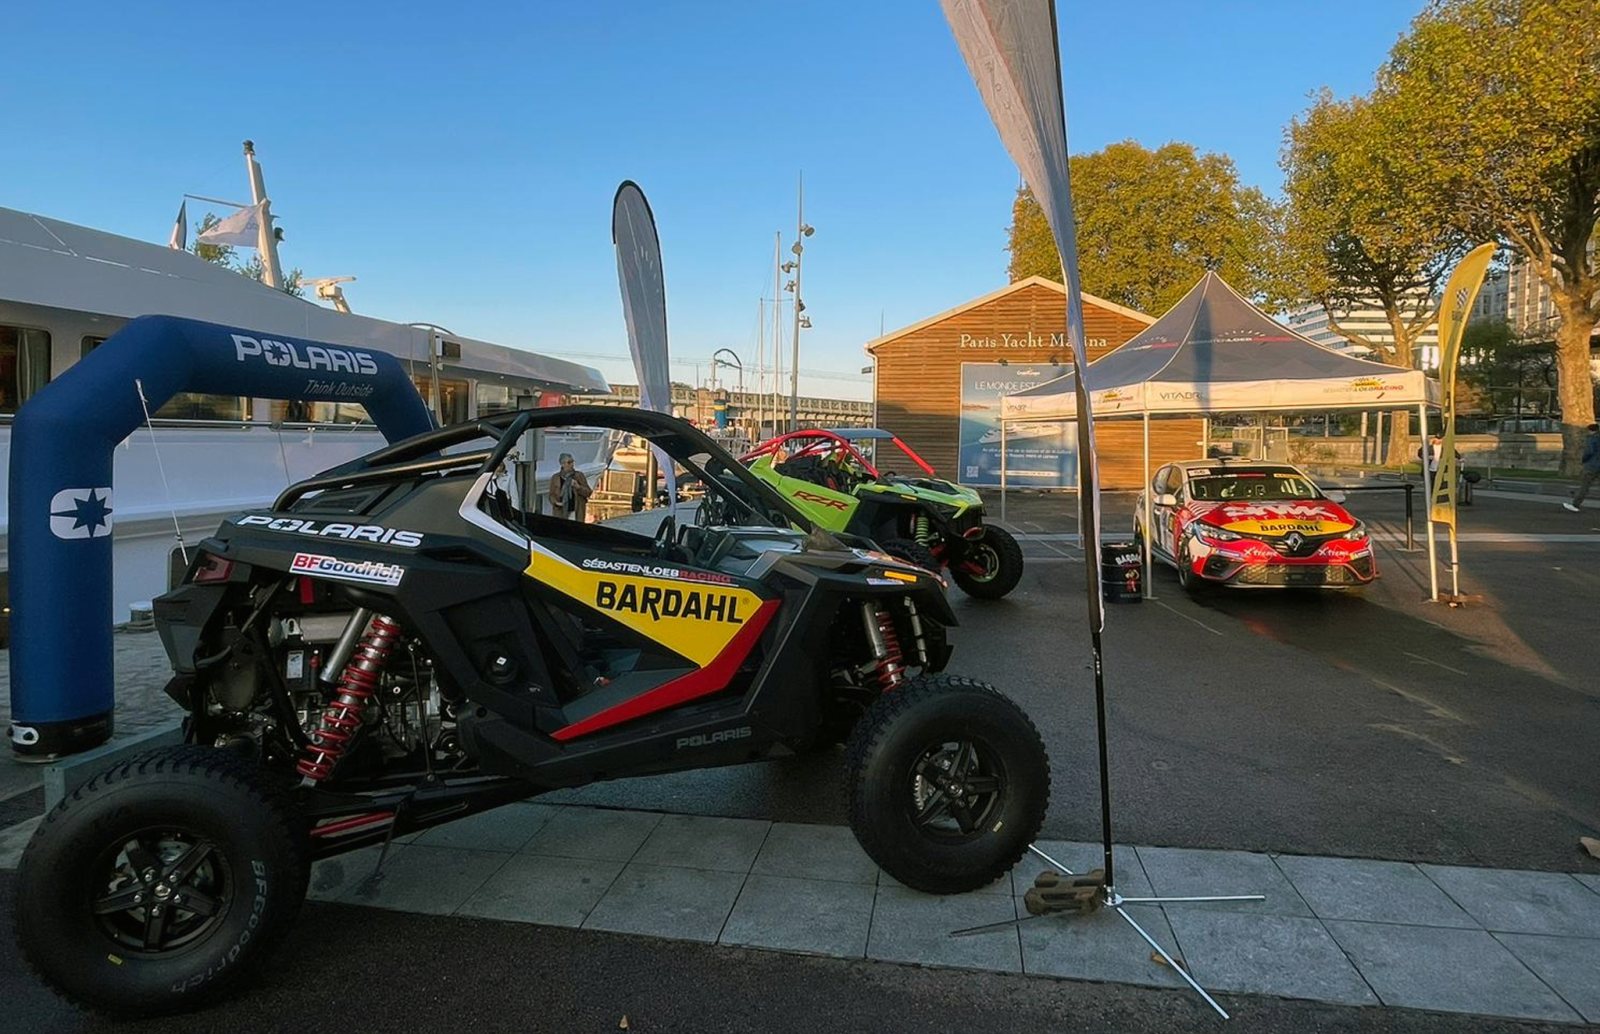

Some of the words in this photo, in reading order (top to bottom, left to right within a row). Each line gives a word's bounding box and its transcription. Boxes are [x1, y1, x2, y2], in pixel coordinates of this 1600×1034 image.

[960, 333, 997, 348] Paris
[1001, 331, 1043, 348] Yacht
[1050, 333, 1107, 348] Maina
[231, 334, 378, 375] POLARIS
[303, 379, 333, 395] Think
[335, 382, 373, 397] Outside
[987, 381, 1018, 391] MONDE
[792, 490, 849, 511] RZR
[236, 515, 425, 548] POLARIS
[1260, 524, 1323, 532] BARDAHL
[293, 555, 403, 581] BFGoodrich
[596, 581, 743, 624] BARDAHL
[676, 726, 752, 749] POLARIS
